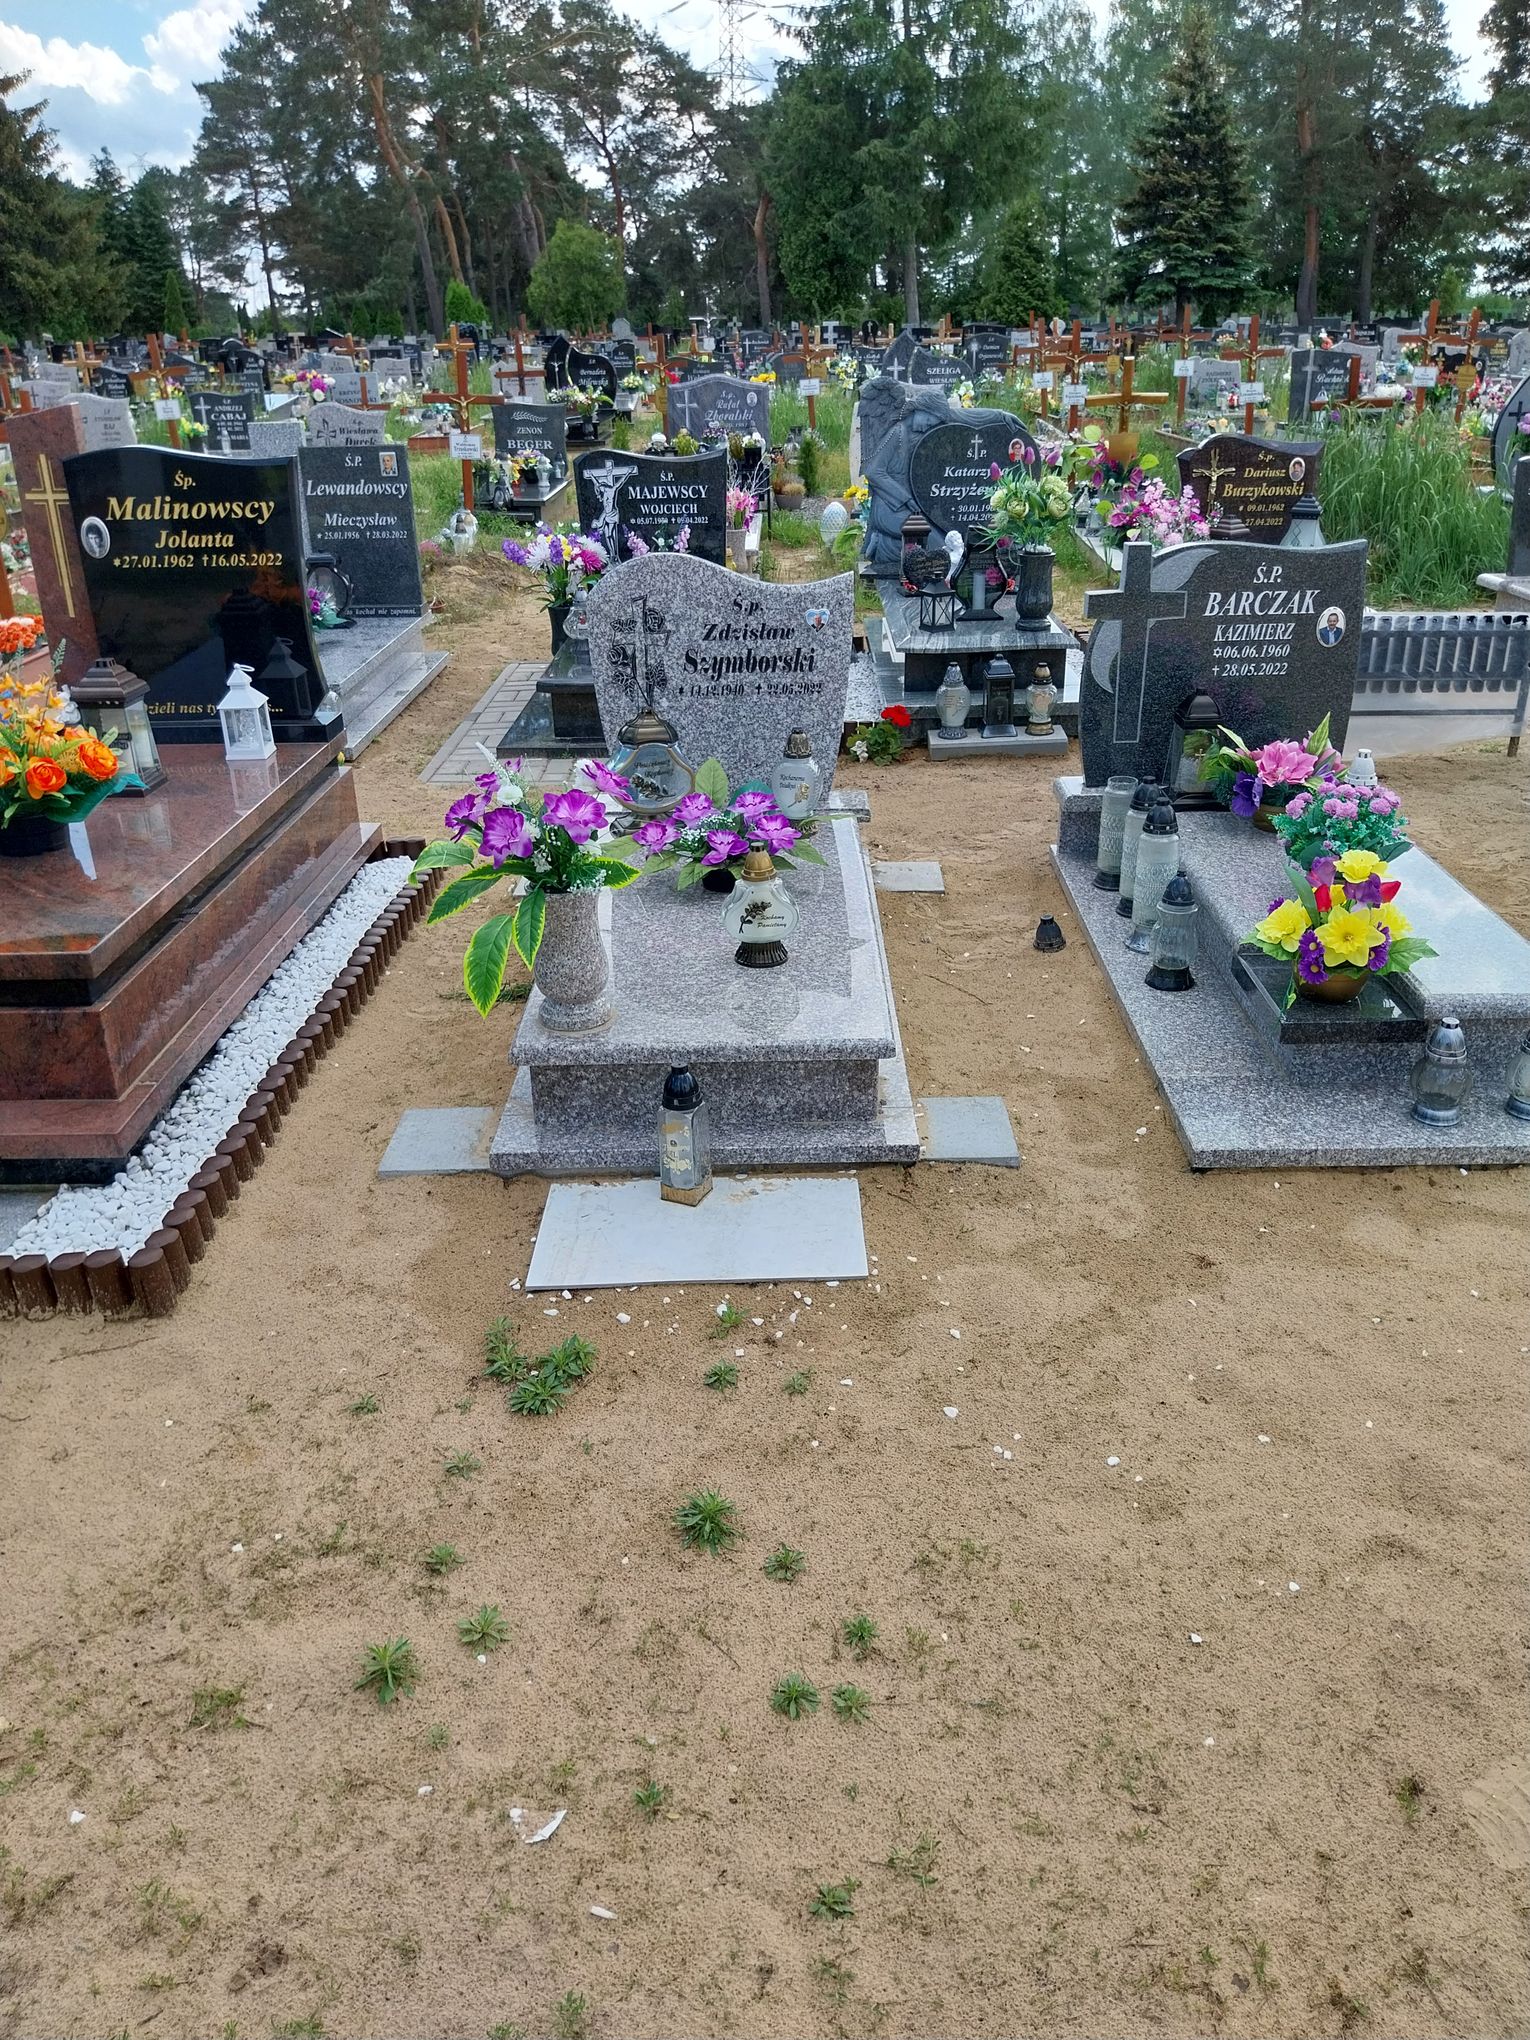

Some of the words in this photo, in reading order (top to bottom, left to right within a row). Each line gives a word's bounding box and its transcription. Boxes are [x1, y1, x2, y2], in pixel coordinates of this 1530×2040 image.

[926, 367, 961, 375] SZELIGA
[516, 427, 543, 435] ZENON
[507, 440, 554, 450] BEGER
[345, 453, 362, 467] Ś.P.
[174, 470, 196, 490] Śp.
[944, 466, 1008, 480] Katarzya
[1244, 467, 1286, 478] Dariusz
[306, 479, 408, 499] Lewandowscy
[628, 485, 708, 499] MAJEWSCY
[1223, 482, 1305, 501] Burzykowski
[106, 496, 275, 525] Malinowscy
[640, 503, 698, 514] WOJCIECH
[324, 512, 397, 529] Mieczysław
[155, 530, 234, 549] Jolanta
[1253, 562, 1283, 583] Ś.P.
[1203, 590, 1320, 616] BARCZAK
[703, 623, 795, 642] Zdzisław
[1214, 623, 1296, 641] KAZIMIERZ
[684, 648, 816, 682] Szymborski
[180, 704, 203, 714] nas
